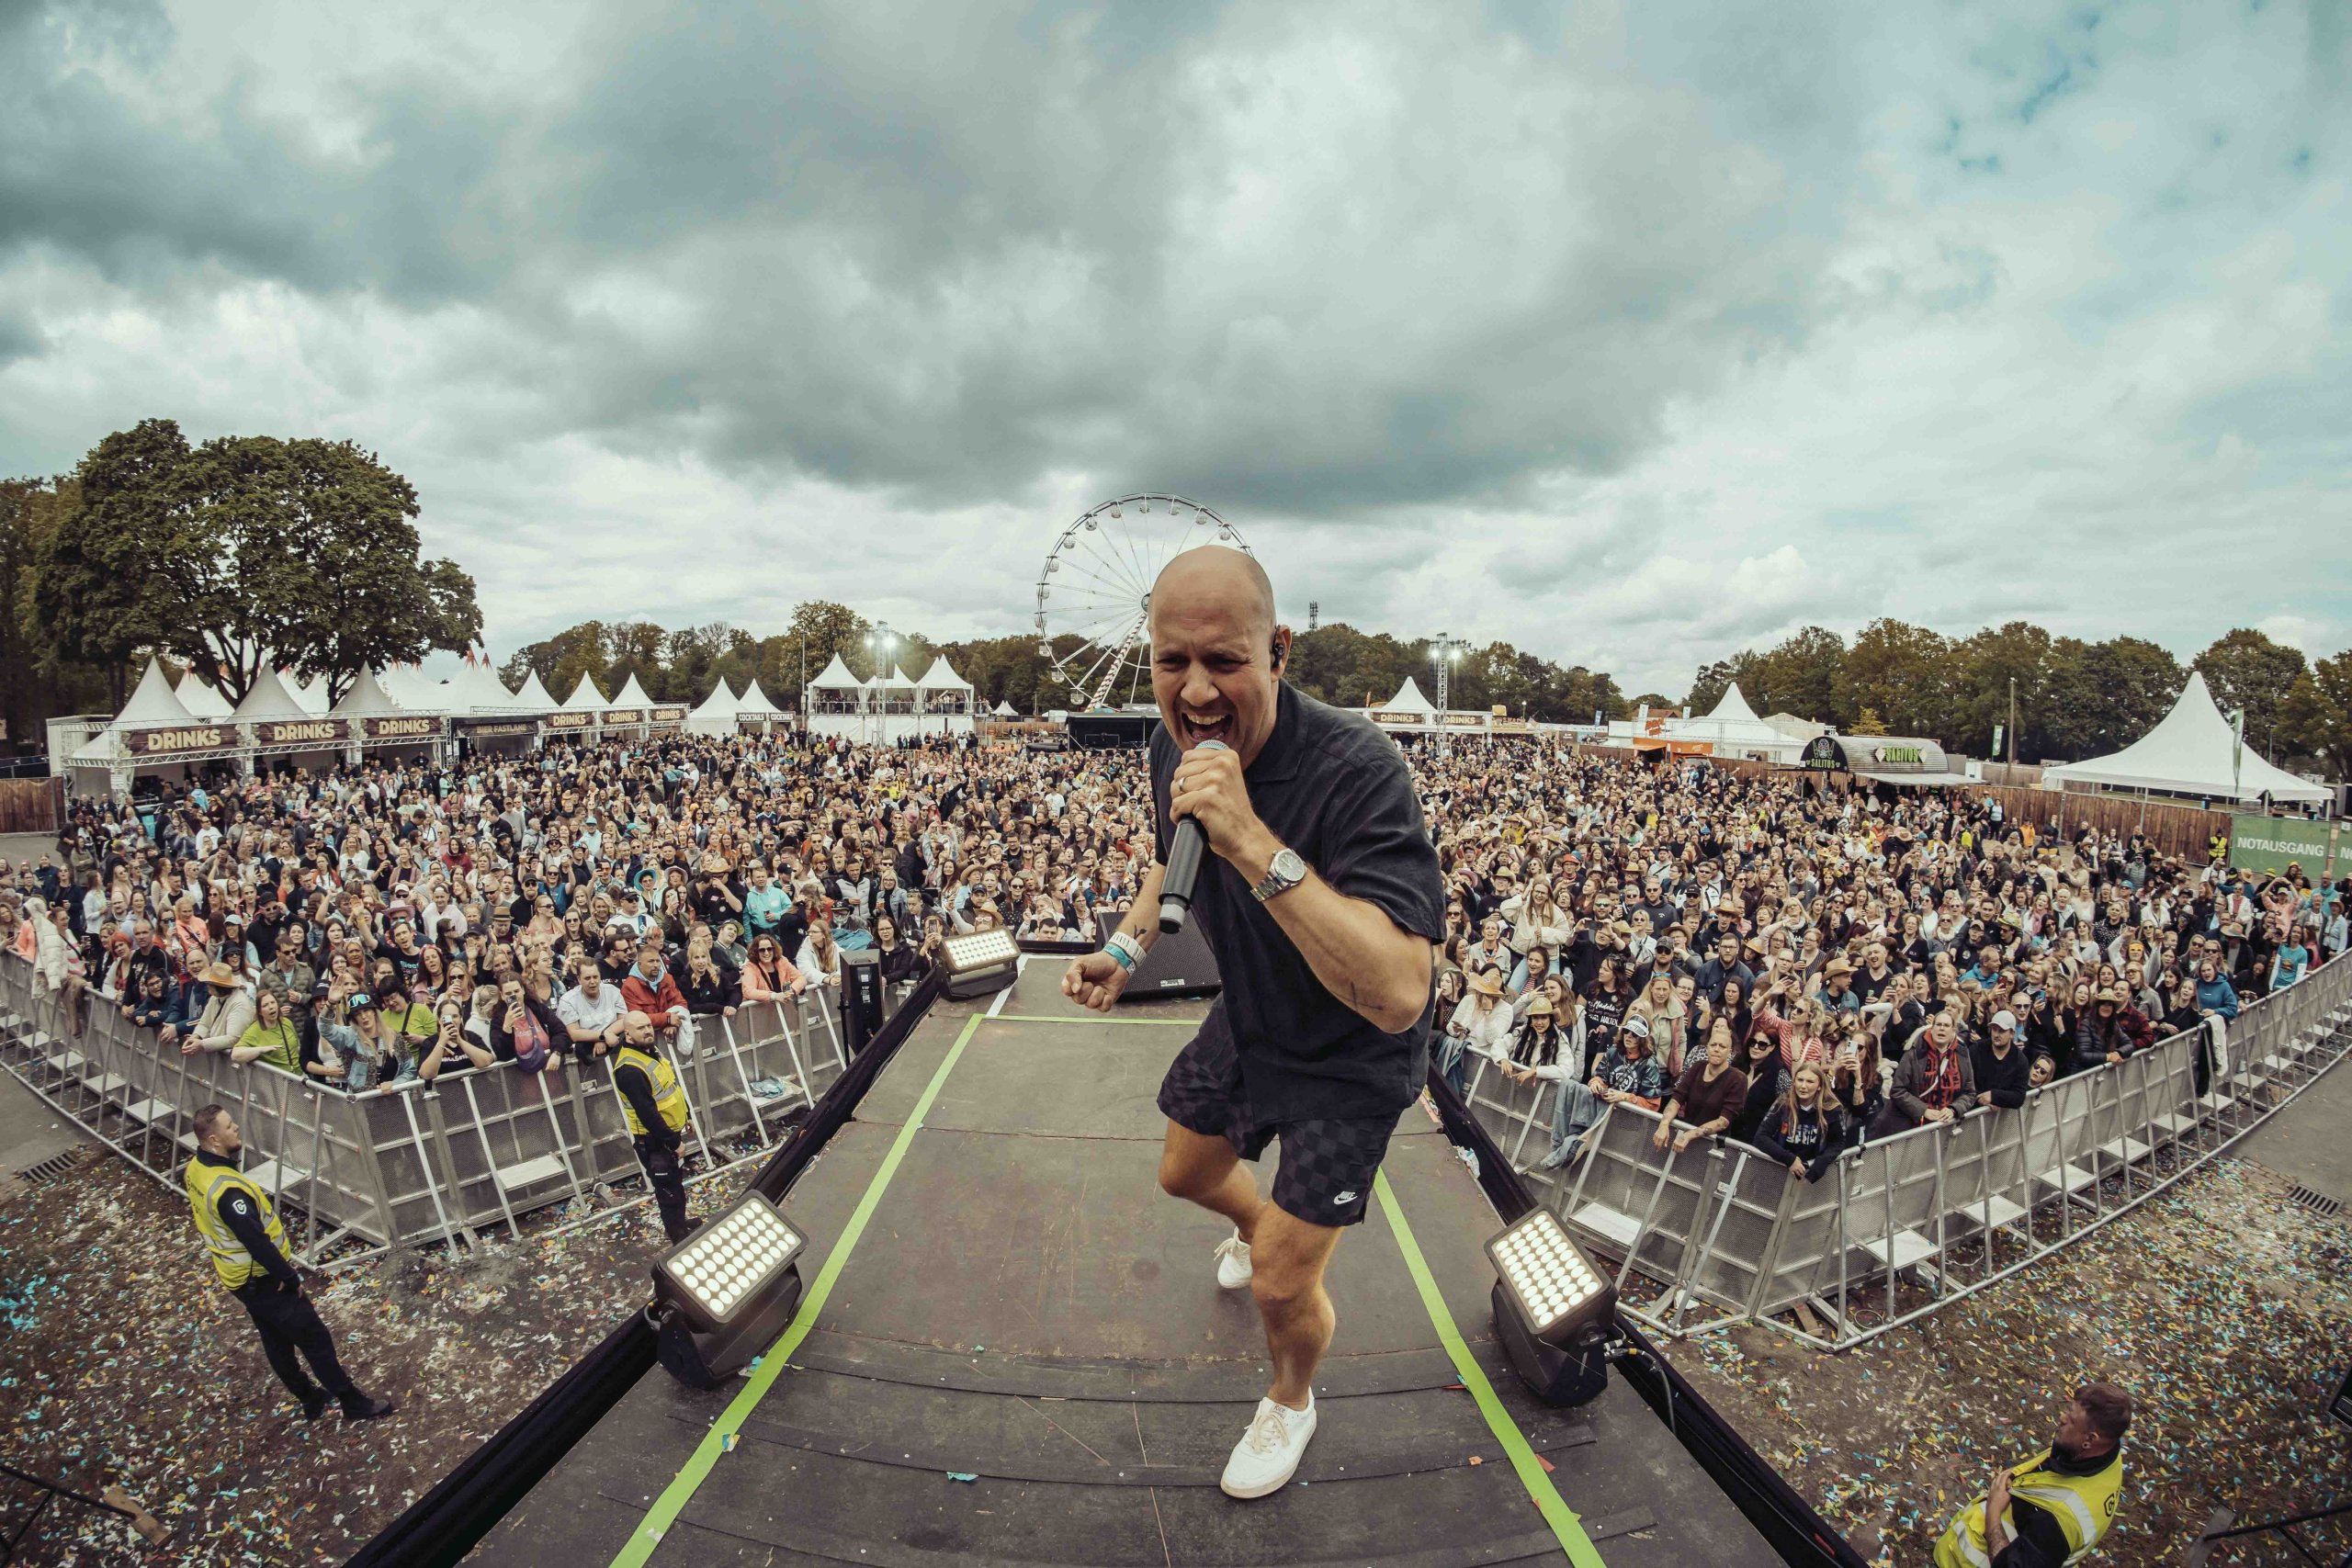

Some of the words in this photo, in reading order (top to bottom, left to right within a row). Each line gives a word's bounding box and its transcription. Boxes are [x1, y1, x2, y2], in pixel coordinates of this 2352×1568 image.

[609, 711, 638, 723] DRINKS
[656, 709, 681, 720] DRINKS
[770, 713, 794, 721] COCKTAILS
[1380, 714, 1415, 722] DRINKS
[379, 719, 430, 735] DRINKS
[553, 715, 586, 727] DRINKS
[274, 723, 335, 741] DRINKS
[148, 729, 221, 750] DRINKS
[1886, 747, 1919, 762] SALITOS
[1811, 758, 1836, 769] SALITOS
[2237, 837, 2324, 857] NOTAUSGANG
